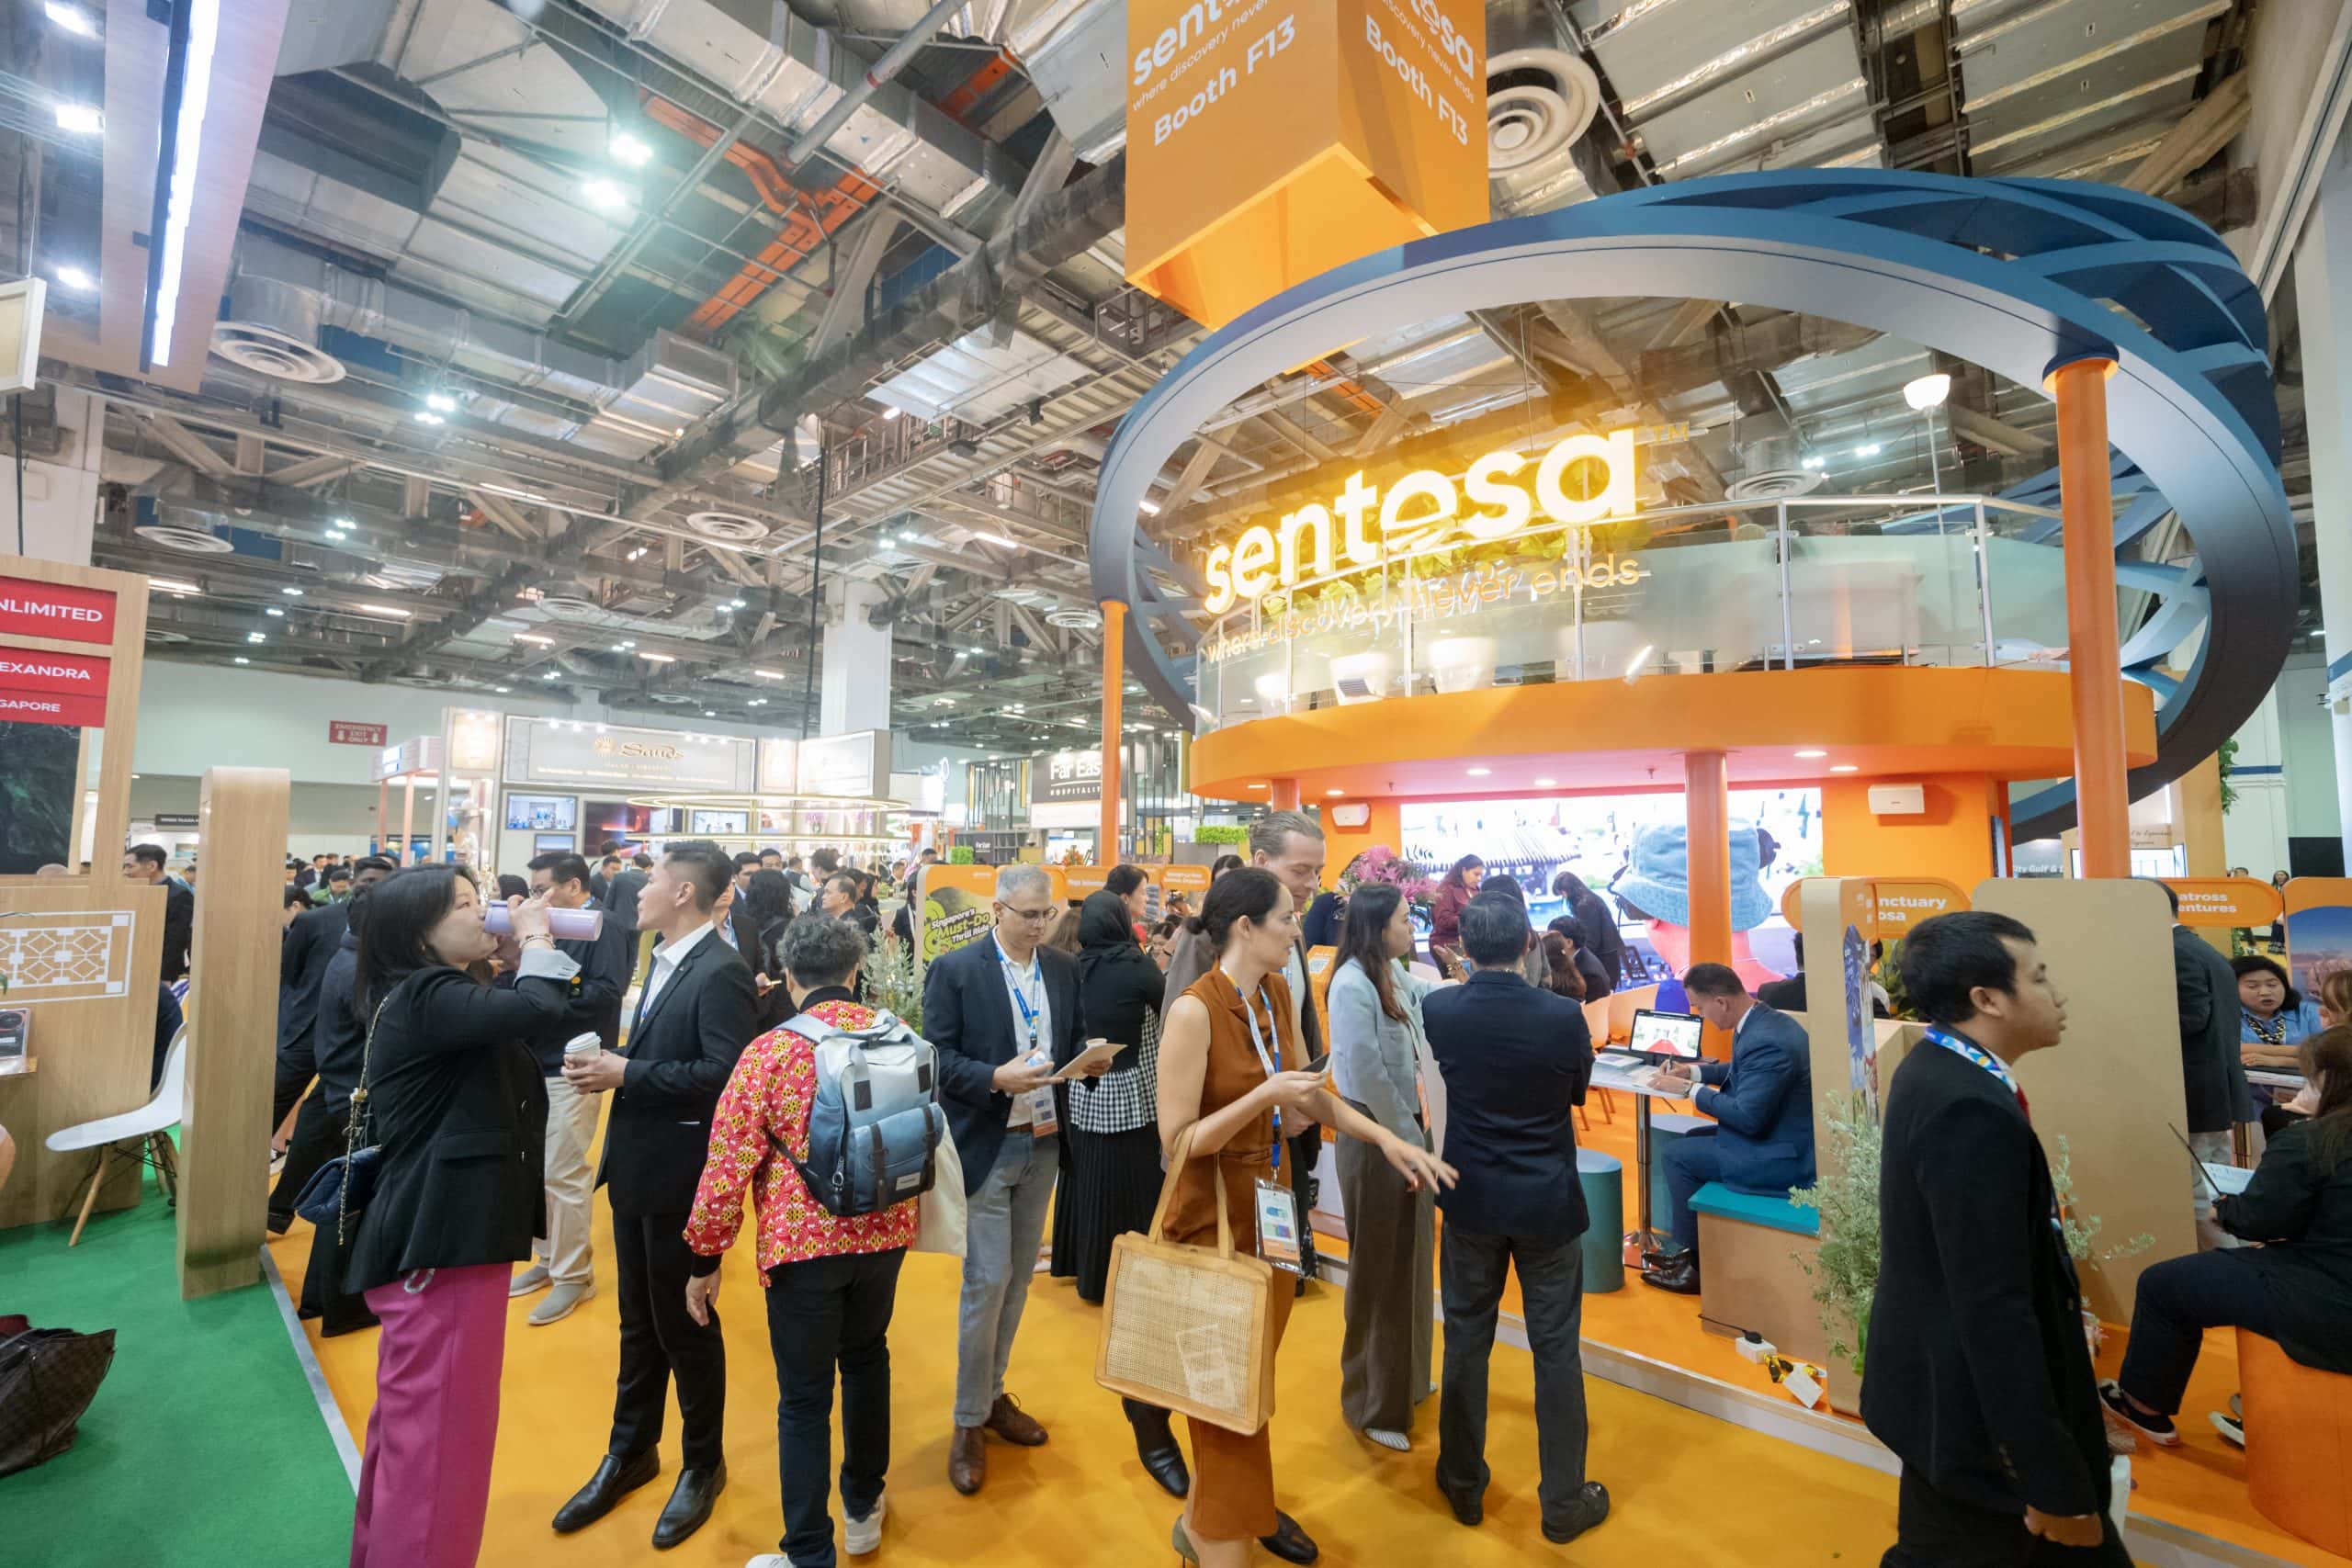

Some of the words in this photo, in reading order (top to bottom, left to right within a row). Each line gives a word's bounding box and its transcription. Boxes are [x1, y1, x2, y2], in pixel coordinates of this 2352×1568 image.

[1132, 78, 1167, 111] where
[1170, 26, 1228, 82] discovery
[1428, 43, 1453, 77] never
[1154, 66, 1237, 147] Booth
[1247, 14, 1295, 74] F13
[1366, 14, 1432, 109] Booth
[1438, 93, 1468, 145] F13
[1532, 552, 1640, 595] ends
[1050, 761, 1072, 780] Far
[1076, 759, 1102, 778] Eas
[1050, 785, 1102, 796] HOSPITALIT
[1879, 897, 1947, 910] nctuary
[2178, 893, 2228, 902] atross
[1878, 911, 1905, 921] osa
[2178, 904, 2237, 913] entures
